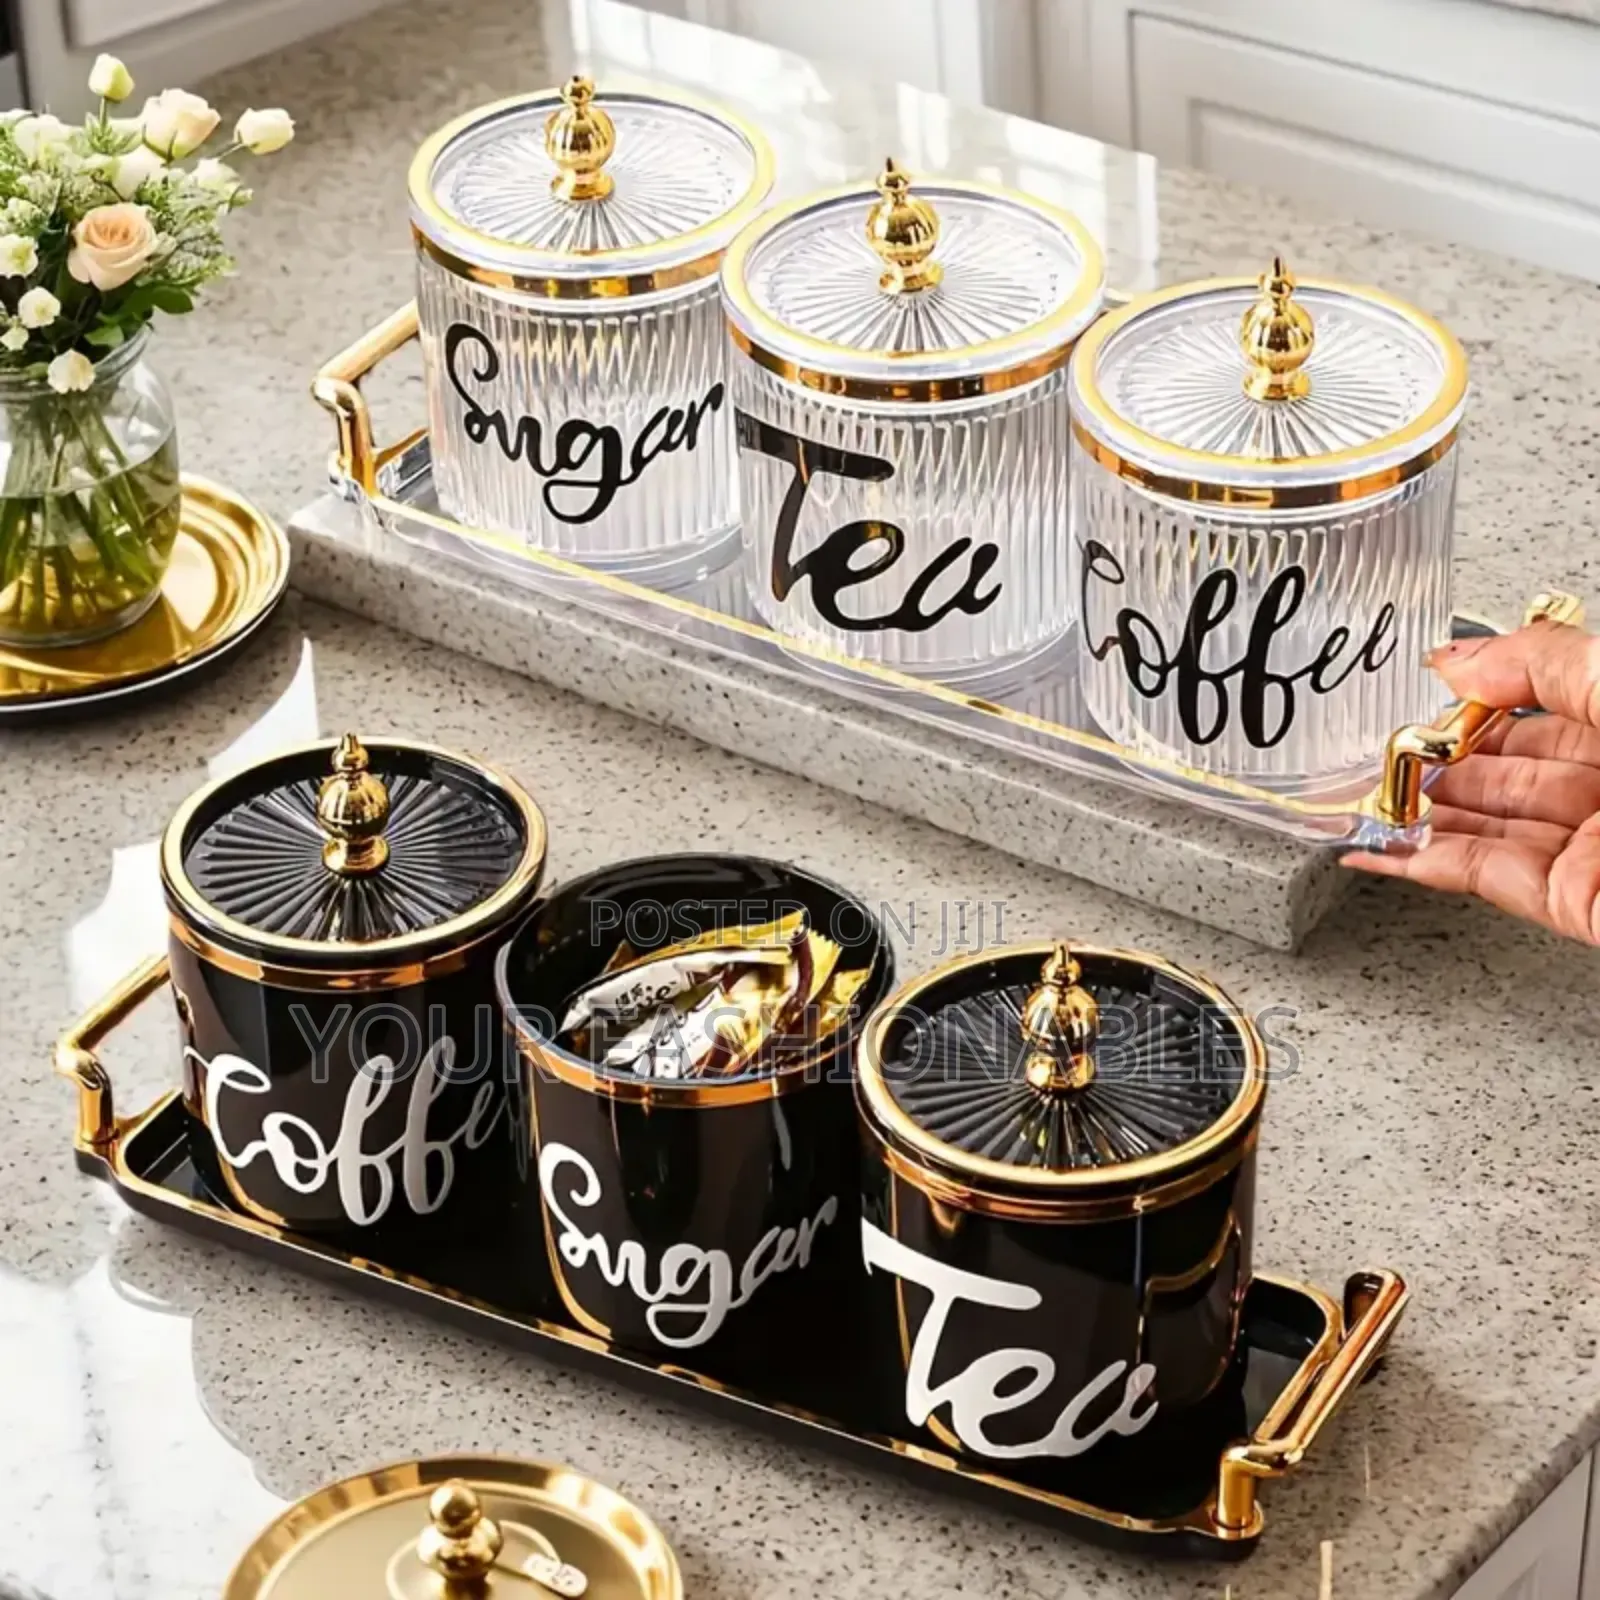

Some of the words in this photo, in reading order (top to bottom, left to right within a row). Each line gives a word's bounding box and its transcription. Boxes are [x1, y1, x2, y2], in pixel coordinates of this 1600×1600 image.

[445, 322, 724, 524] Sugar
[734, 405, 1002, 632] Tea
[1075, 535, 1398, 748] Coffee
[539, 1142, 838, 1348] Sugar
[861, 1216, 1159, 1459] Tea
